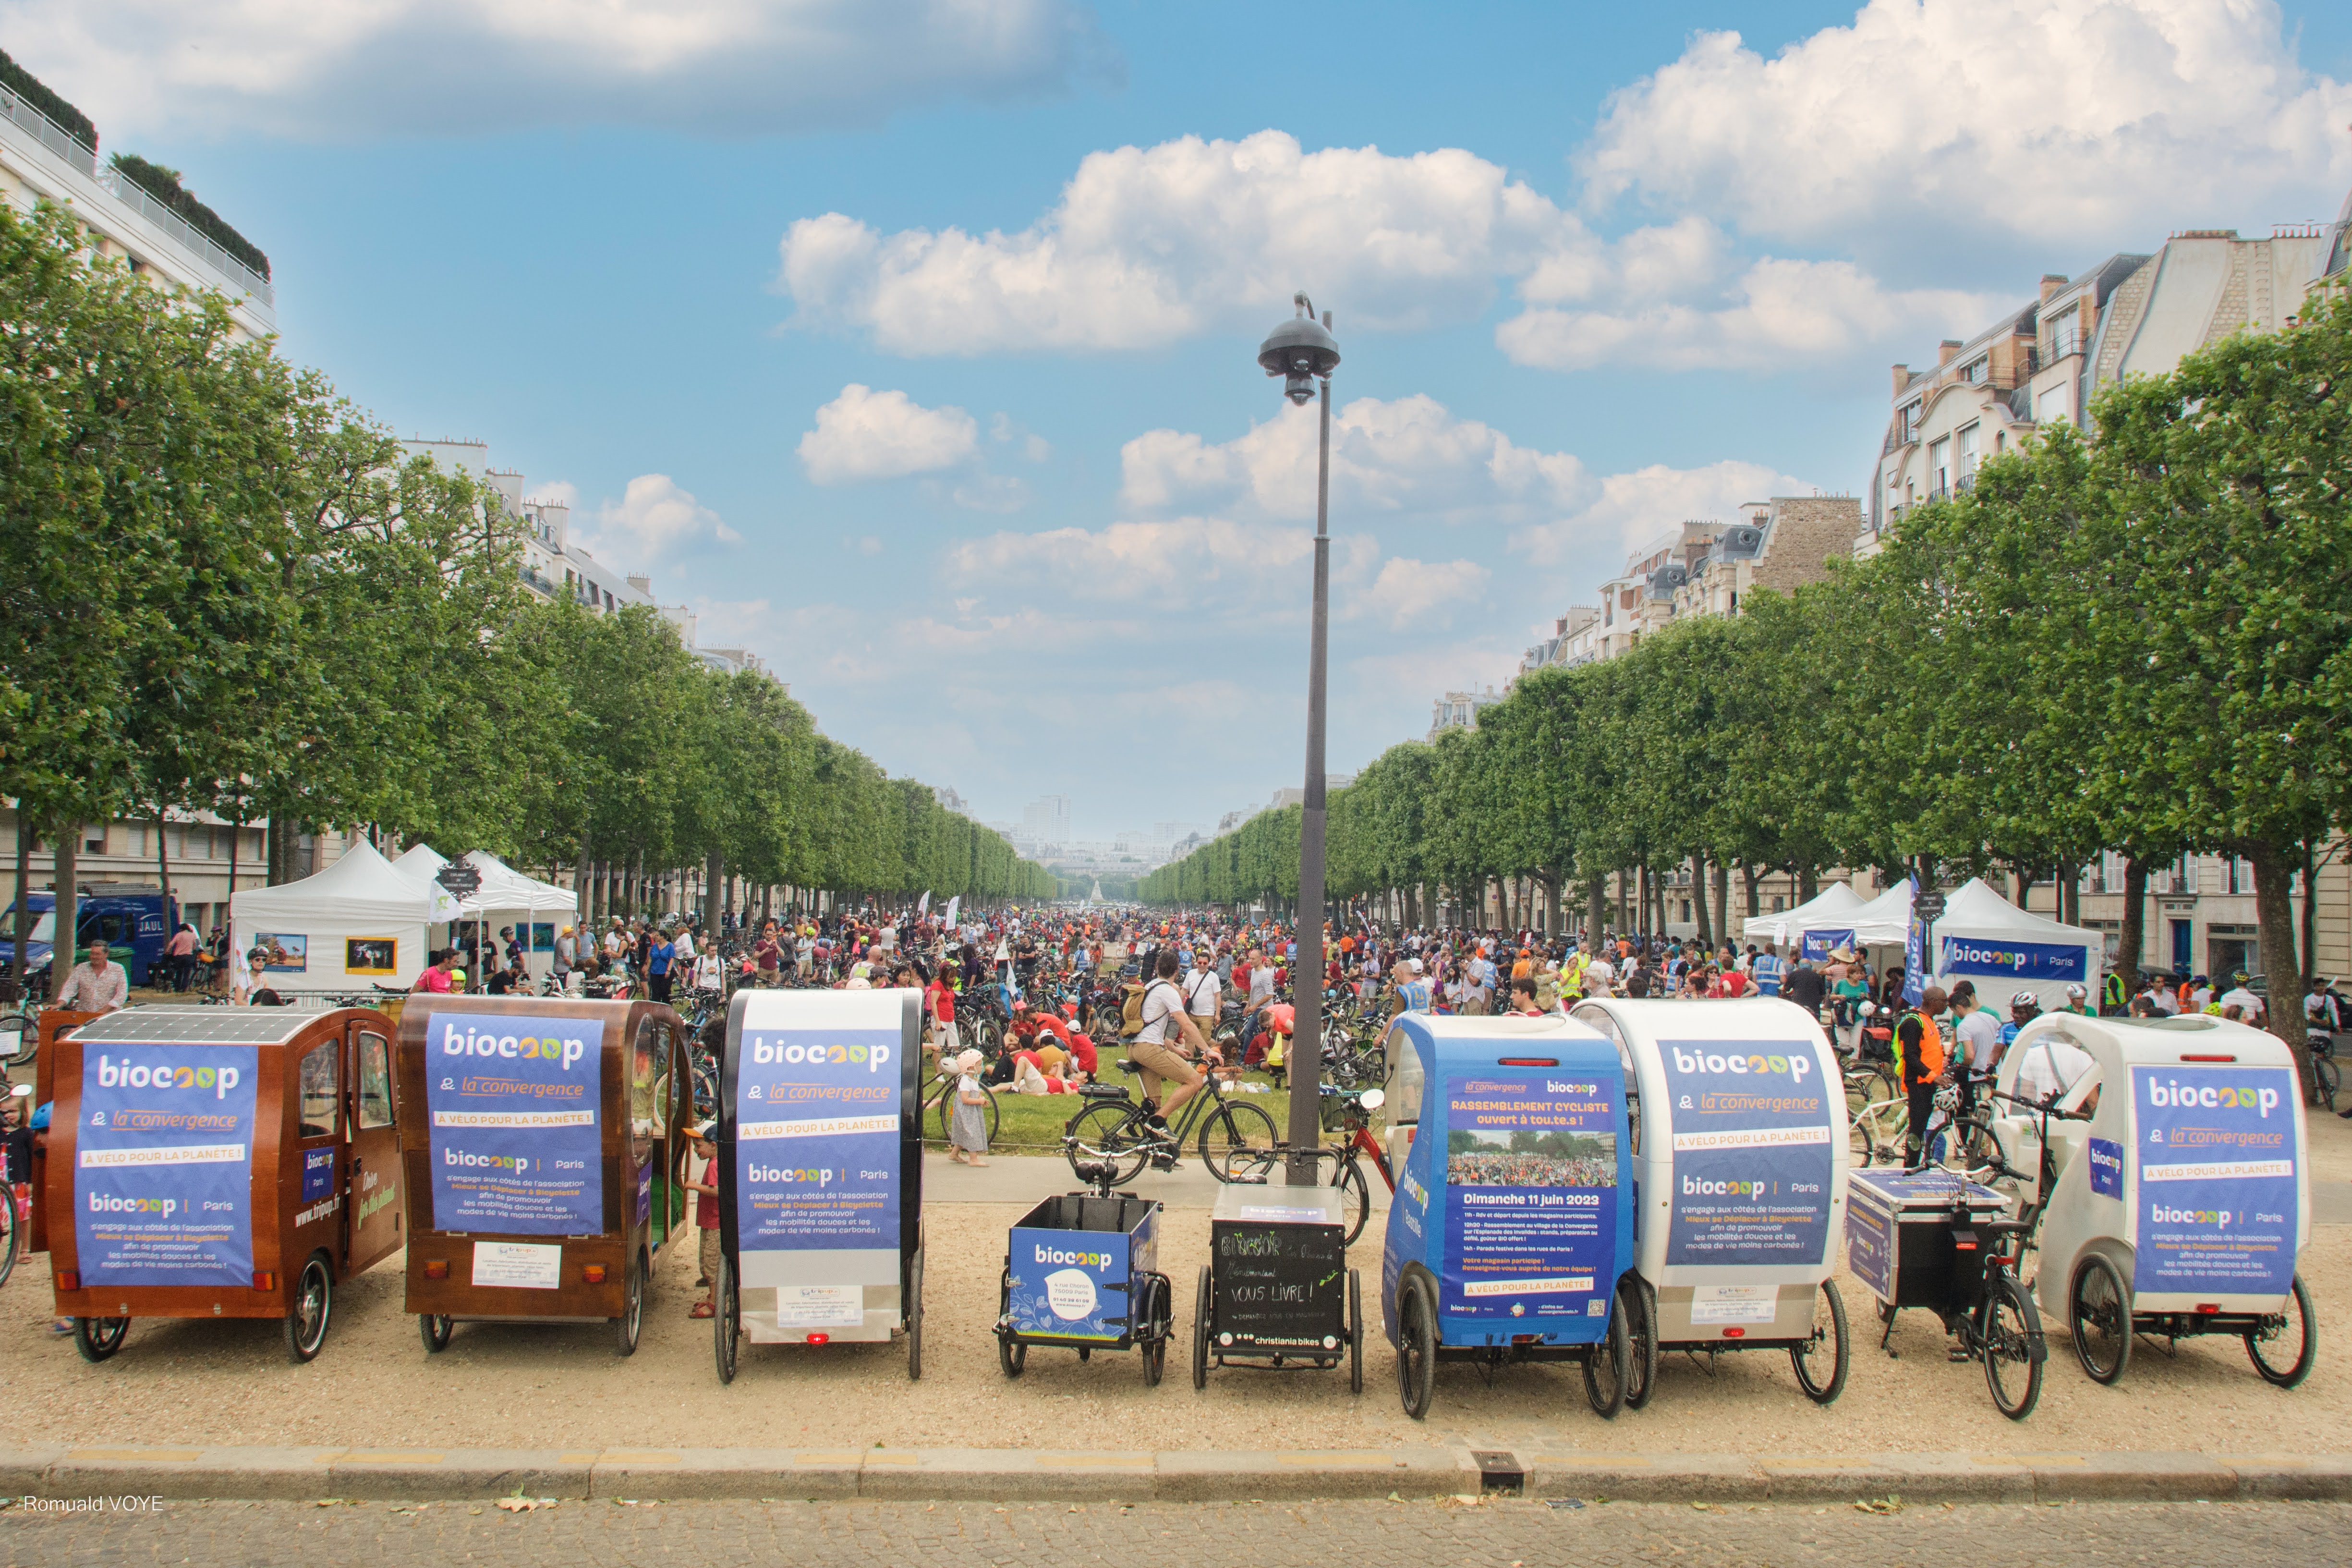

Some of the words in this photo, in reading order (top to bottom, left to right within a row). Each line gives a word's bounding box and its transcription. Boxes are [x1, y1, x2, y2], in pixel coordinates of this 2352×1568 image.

[1953, 943, 2026, 971] biocoop
[2049, 957, 2074, 966] Paris
[444, 1023, 583, 1070] biocoop
[754, 1037, 889, 1072] biocoop
[1673, 1046, 1810, 1083] biocoop
[98, 1055, 239, 1099] biocoop
[440, 1078, 455, 1090] &
[462, 1077, 476, 1091] la
[482, 1080, 584, 1097] convergence
[748, 1085, 762, 1098] &
[770, 1083, 785, 1098] la
[789, 1087, 890, 1102] convergence
[1466, 1082, 1473, 1090] la
[1475, 1083, 1527, 1093] convergence
[1547, 1080, 1597, 1096] biocoop
[1452, 1101, 1552, 1111] RASSEMBLEMENT
[1554, 1103, 1609, 1112] CYCLISTE
[1679, 1095, 1693, 1109] &
[1701, 1094, 1715, 1109] la
[1720, 1097, 1819, 1112] convergence
[2149, 1076, 2279, 1118] biocoop
[90, 1111, 106, 1126] &
[113, 1110, 128, 1126] la
[132, 1114, 238, 1130] convergence
[438, 1113, 446, 1123] À
[449, 1114, 477, 1123] VÉLO
[743, 1126, 751, 1135] À
[754, 1125, 783, 1135] VÉLO
[787, 1124, 817, 1133] POUR
[838, 1119, 888, 1130] PLANÈTE
[1477, 1116, 1517, 1124] ouvert
[1520, 1114, 1528, 1124] à
[1530, 1115, 1576, 1125] tou.te.s
[1678, 1136, 1685, 1146] À
[1688, 1135, 1716, 1145] VÉLO
[1720, 1135, 1750, 1144] POUR
[1754, 1134, 1766, 1143] LA
[2150, 1130, 2164, 1143] &
[2170, 1128, 2184, 1142] la
[2189, 1132, 2282, 1146] convergence
[97, 1151, 125, 1163] VÉLO
[130, 1152, 161, 1161] POUR
[307, 1153, 333, 1169] biocoop
[445, 1148, 528, 1175] biocoop
[556, 1160, 584, 1168] Paris
[2092, 1147, 2122, 1174] biocoop
[749, 1163, 833, 1187] biocoop
[860, 1170, 888, 1179] Paris
[2147, 1168, 2154, 1177] À
[2158, 1167, 2183, 1177] VÉLO
[2187, 1167, 2215, 1176] POUR
[313, 1178, 324, 1187] Paris
[1404, 1164, 1429, 1216] biocoop
[1683, 1175, 1765, 1201] biocoop
[1792, 1183, 1819, 1192] Paris
[89, 1192, 177, 1219] biocoop
[203, 1201, 233, 1211] Paris
[1464, 1194, 1525, 1204] Dimanche
[1528, 1195, 1538, 1204] 11
[1540, 1194, 1564, 1207] juin
[1566, 1195, 1599, 1205] 2023
[295, 1193, 340, 1228] www.tripup.fr
[1250, 1207, 1318, 1216] biocoop
[2152, 1203, 2232, 1229] biocoop
[2255, 1213, 2284, 1222] Paris
[1406, 1209, 1421, 1238] Bastille
[1035, 1244, 1112, 1272] biocoop
[1231, 1286, 1265, 1302] VOUS
[1309, 1281, 1312, 1302] !
[1467, 1285, 1473, 1293] À
[1477, 1284, 1499, 1292] VÉLO
[1544, 1281, 1584, 1289] PLANÈTE
[1451, 1304, 1477, 1313] biocoop
[1255, 1337, 1297, 1346] christiania
[1298, 1338, 1320, 1346] bikes
